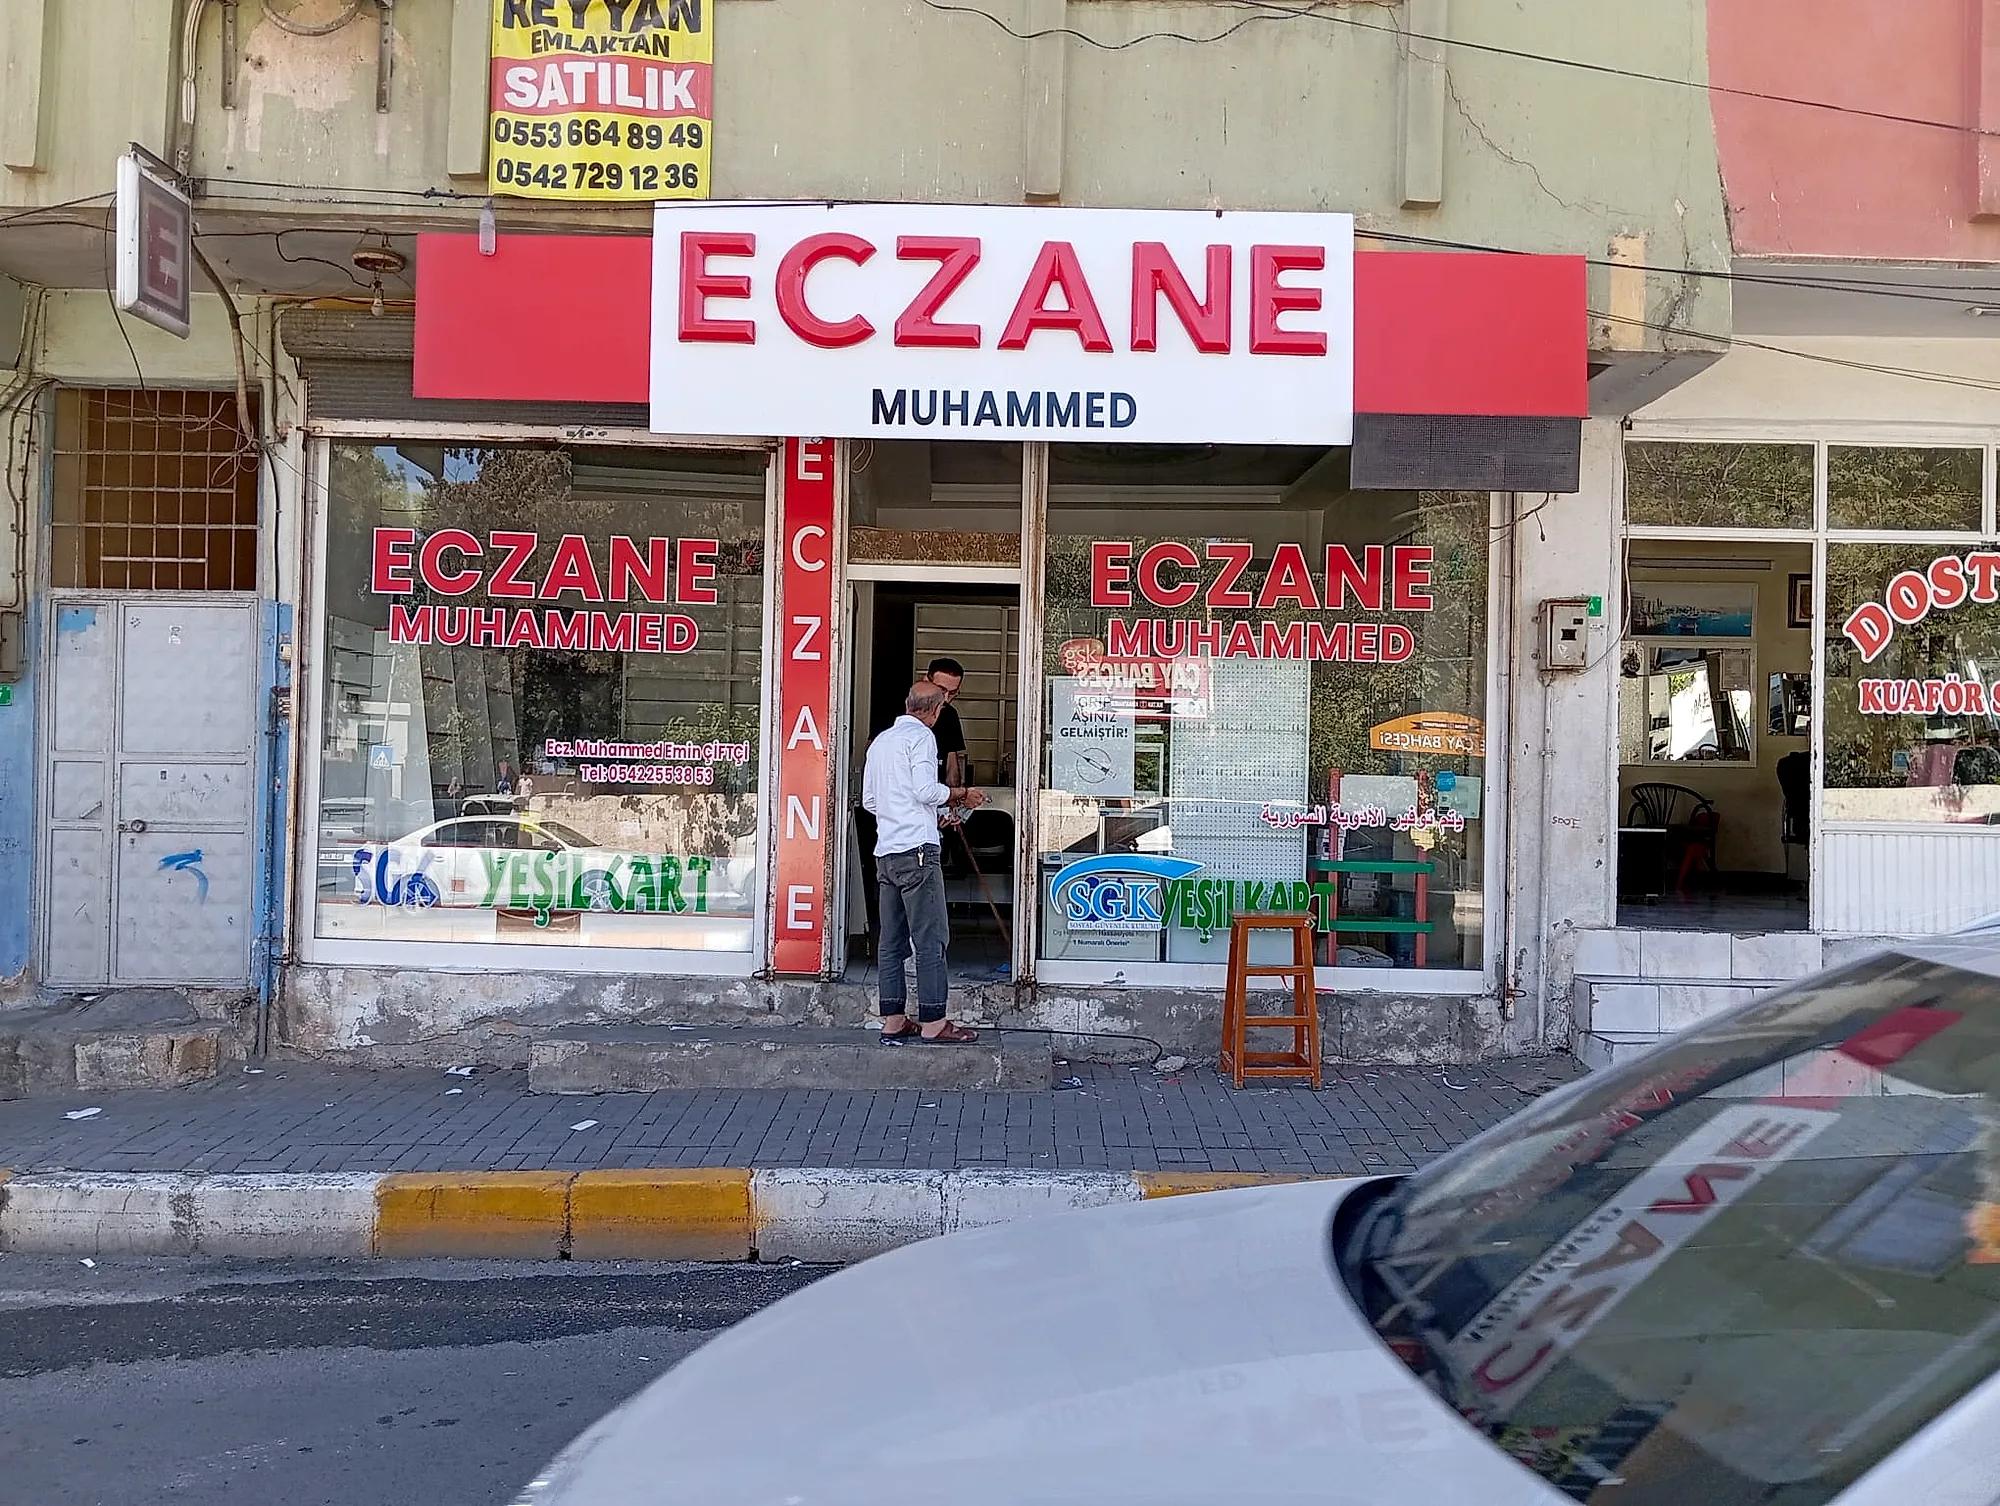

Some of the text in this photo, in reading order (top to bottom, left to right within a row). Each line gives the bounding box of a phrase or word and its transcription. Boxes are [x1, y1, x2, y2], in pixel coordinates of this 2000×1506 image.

[502, 0, 701, 33] REYYAN
[531, 29, 671, 57] EMLAKTAN
[504, 62, 697, 110] SATILIK
[495, 118, 704, 150] 0553 664 89 49
[496, 158, 699, 190] 0542 729 12 36
[149, 203, 178, 300] E
[677, 230, 1329, 356] ECZANE
[871, 388, 1138, 429] MUHAMMED
[371, 527, 720, 605] ECZANE
[1091, 541, 1434, 611] ECZANE
[389, 605, 700, 654] MUHAMMED
[1842, 552, 2000, 664] DOST
[1065, 645, 1098, 669] gsk
[1108, 618, 1415, 663] MUHAMMED
[784, 437, 827, 931] ECZANE
[1859, 673, 1985, 716] KUAFÖR
[545, 740, 574, 757] Ecz.
[576, 740, 664, 759] Muhammed
[665, 743, 701, 760] Emin
[1060, 725, 1128, 741] GELMİŞTİR!
[1066, 880, 1162, 922] SGK
